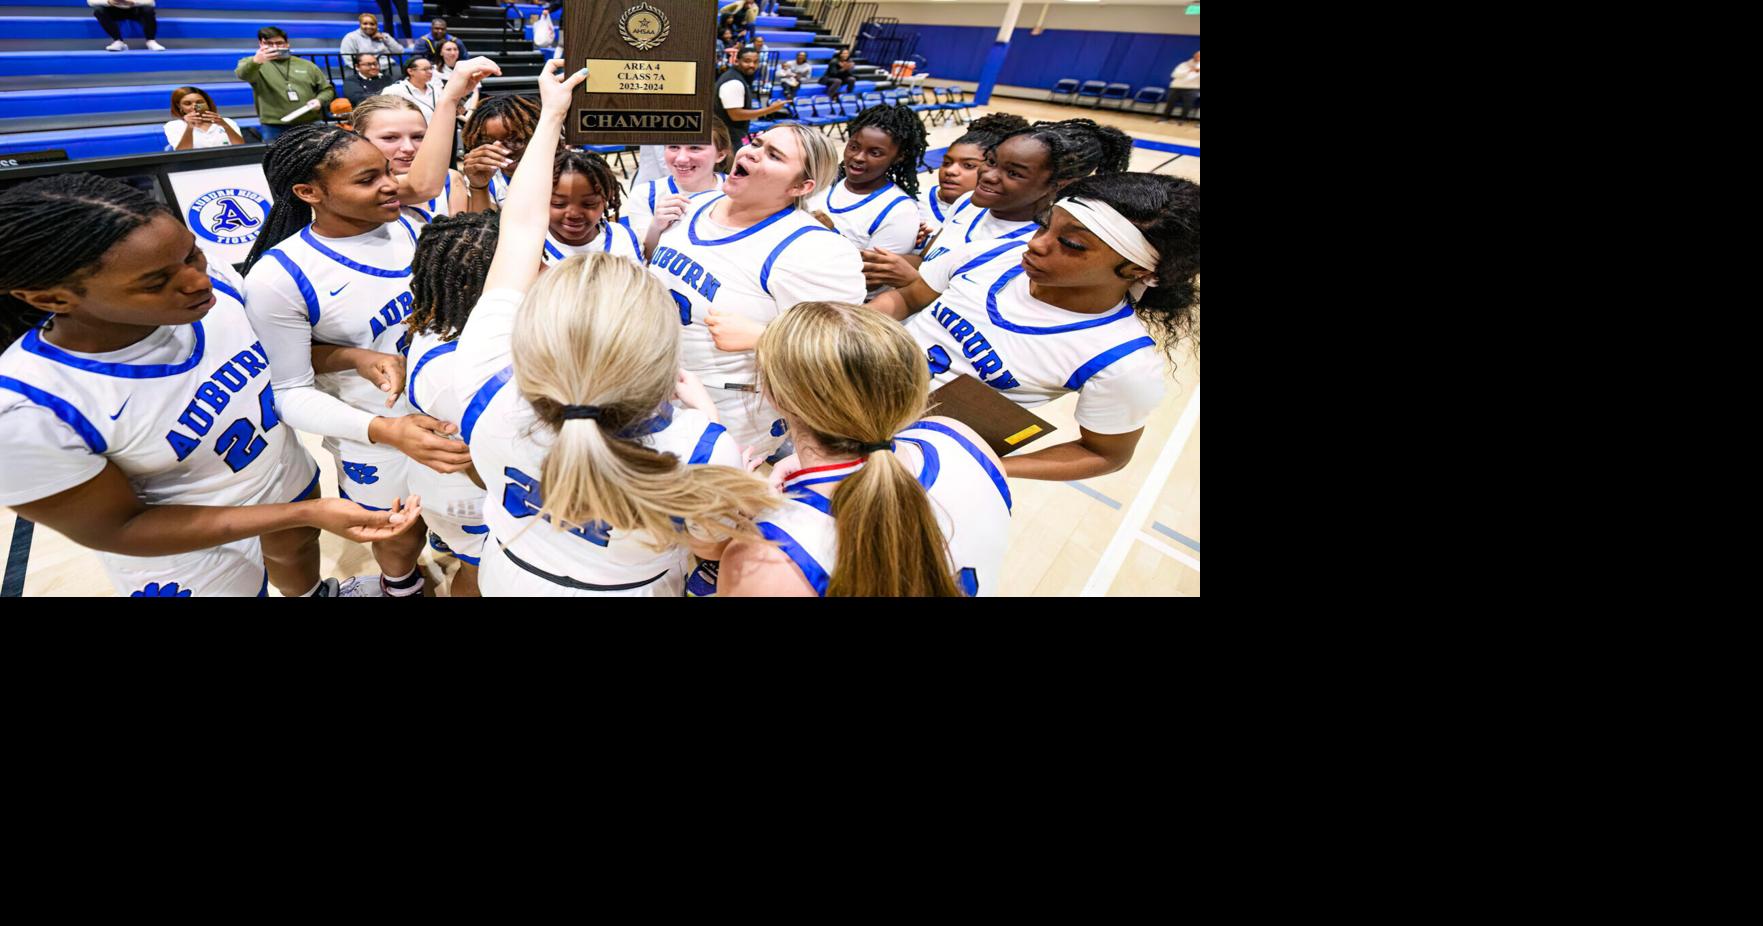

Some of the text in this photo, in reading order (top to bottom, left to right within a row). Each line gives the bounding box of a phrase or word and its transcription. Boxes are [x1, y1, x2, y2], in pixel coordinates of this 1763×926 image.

[624, 63, 660, 71] AREA 4
[617, 73, 666, 81] CLASS 7A
[619, 82, 664, 91] 2023-2024
[582, 114, 699, 129] CHAMPION
[191, 188, 235, 212] AUBURN
[211, 197, 261, 233] A
[651, 246, 722, 303] UBURN
[369, 291, 414, 343] AUB
